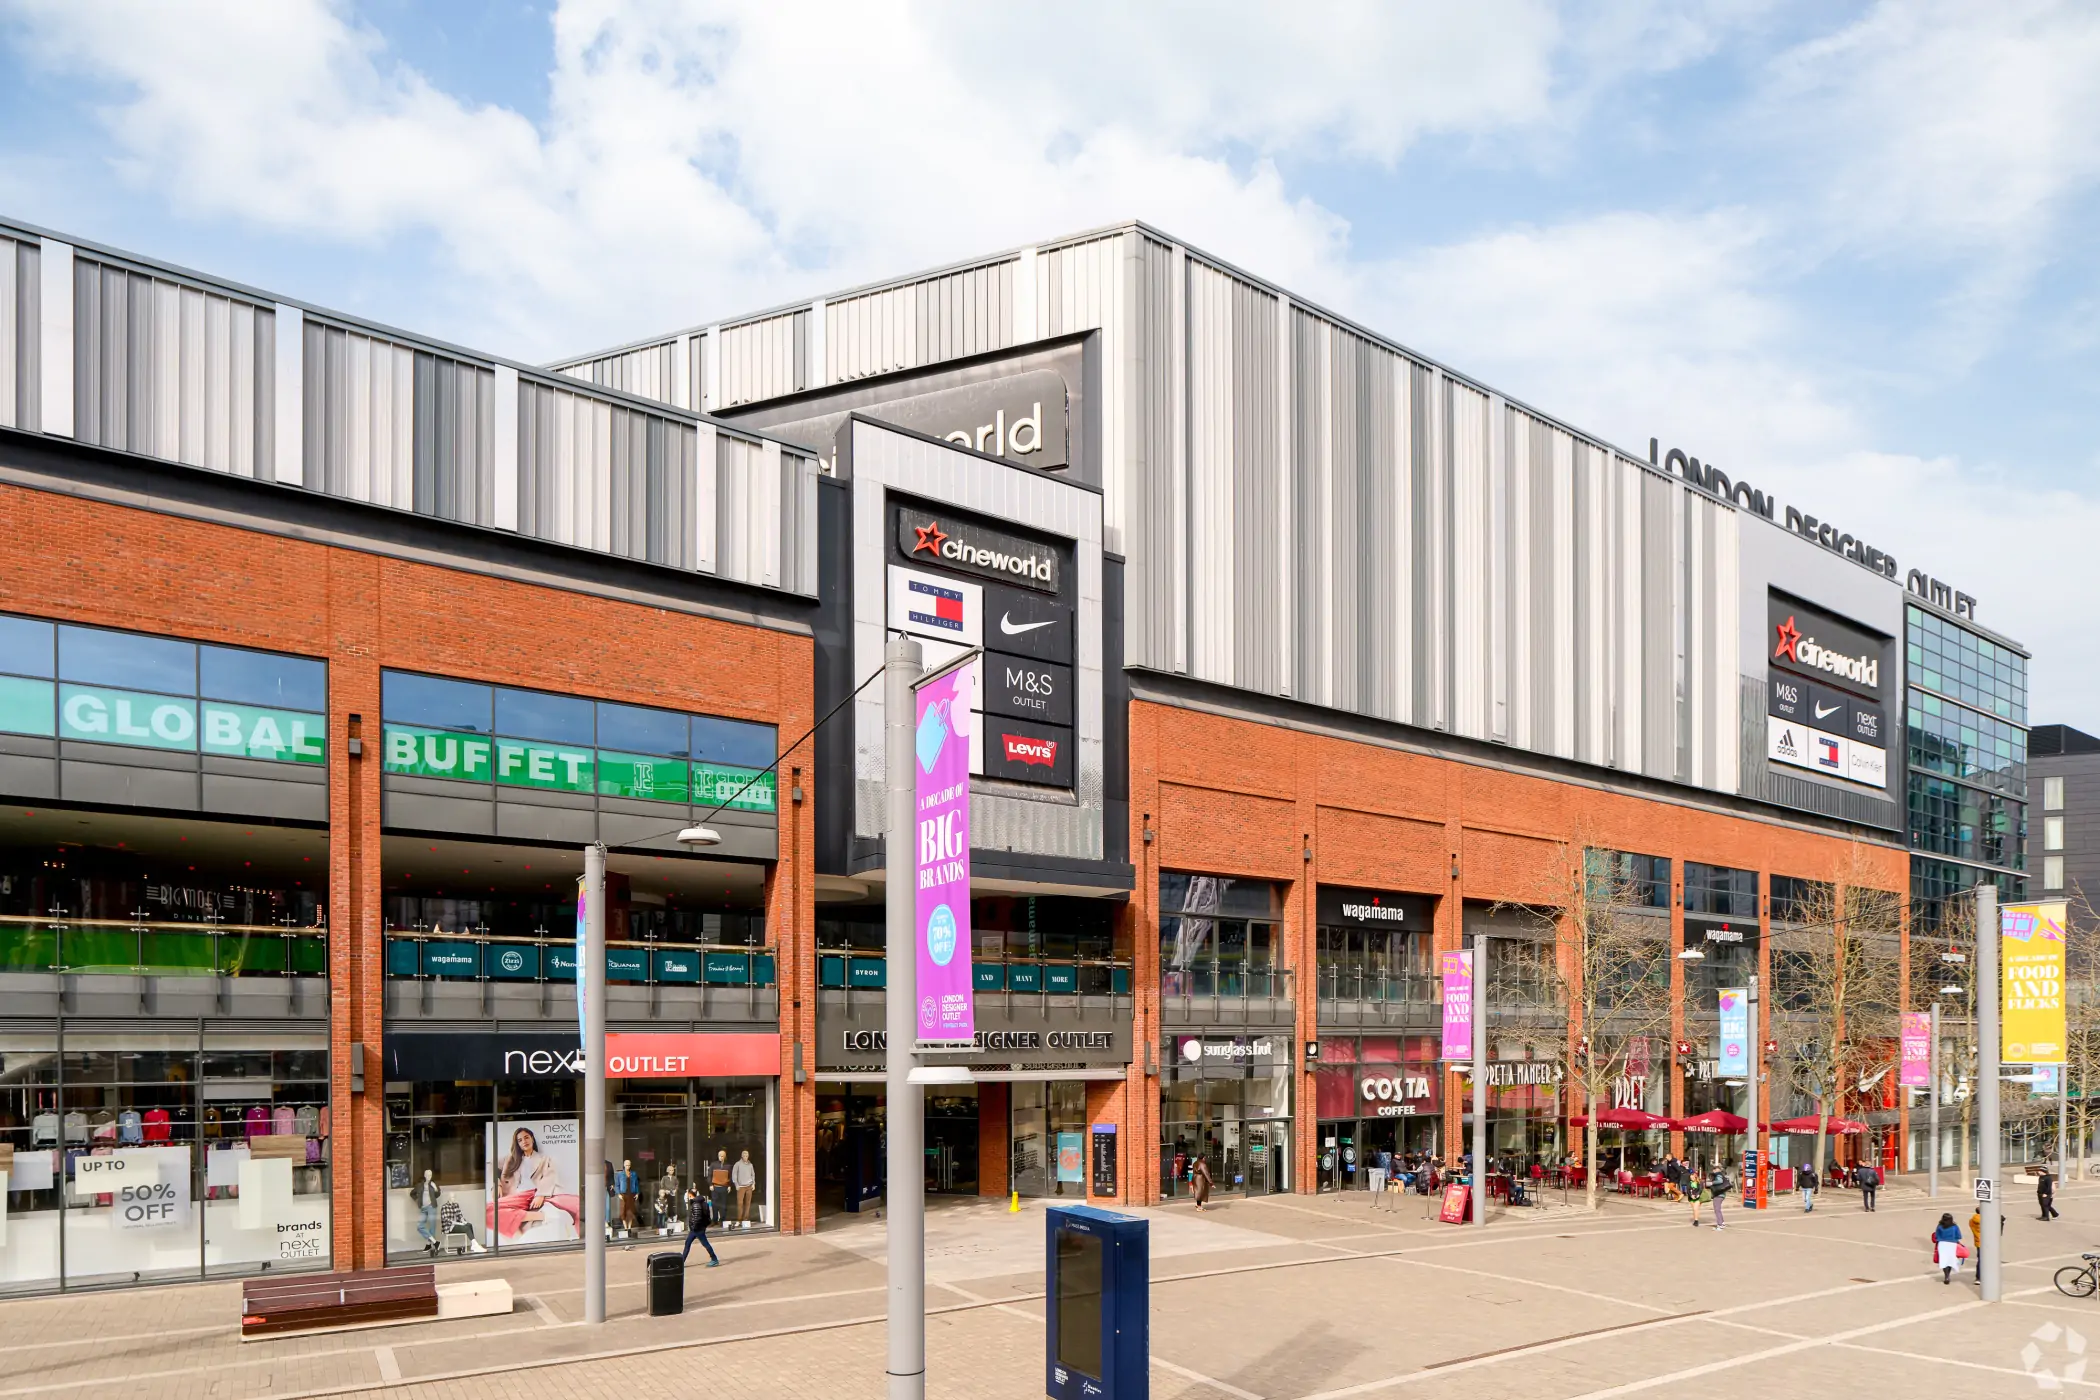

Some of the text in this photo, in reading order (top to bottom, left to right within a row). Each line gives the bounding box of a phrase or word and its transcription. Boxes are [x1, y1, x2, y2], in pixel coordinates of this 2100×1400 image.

[1650, 438, 1977, 620] LONDON DESIGNER OUTLET
[942, 539, 1051, 582] cineworld
[913, 583, 959, 599] TOMMY
[912, 613, 959, 629] HILFIGER
[1796, 637, 1878, 688] cineworld
[1006, 667, 1053, 696] M&S
[1776, 681, 1798, 703] M&S
[1013, 696, 1047, 710] OUTLET
[1779, 703, 1795, 714] OUTLET
[1857, 711, 1878, 728] next
[1857, 724, 1878, 737] OUTLET
[63, 694, 588, 785] GLOBAL BUFFET
[1777, 745, 1798, 758] adidas
[715, 771, 770, 787] GLOBAL
[720, 787, 768, 800] BUFFET
[920, 798, 925, 811] A
[926, 786, 955, 809] DECADE
[920, 809, 964, 866] BIG
[920, 859, 965, 890] BRANDS
[161, 885, 181, 906] BIG
[1343, 903, 1404, 922] wagamama
[431, 954, 473, 964] wagamama
[2007, 965, 2060, 980] FOOD
[2008, 980, 2060, 997] AND
[942, 995, 964, 1004] LONDON
[1446, 993, 1469, 1003] FOOD
[2007, 998, 2060, 1010] FLICKS
[942, 1003, 969, 1013] DESIGNER
[1448, 1003, 1470, 1015] AND
[942, 1012, 961, 1021] OUTLET
[844, 1031, 887, 1050] LON
[1046, 1031, 1113, 1050] OUTLET
[609, 1056, 689, 1073] OUTLET
[1517, 1063, 1551, 1085] MANGER
[1361, 1077, 1431, 1103] COSTA
[1615, 1076, 1646, 1110] PRET
[1377, 1105, 1416, 1116] COFFEE
[543, 1124, 575, 1133] next
[83, 1160, 125, 1172] UP TO
[121, 1183, 176, 1202] 50%
[125, 1203, 174, 1222] OFF
[277, 1221, 322, 1233] brands
[280, 1239, 320, 1250] next
[280, 1249, 319, 1259] OUTLET
